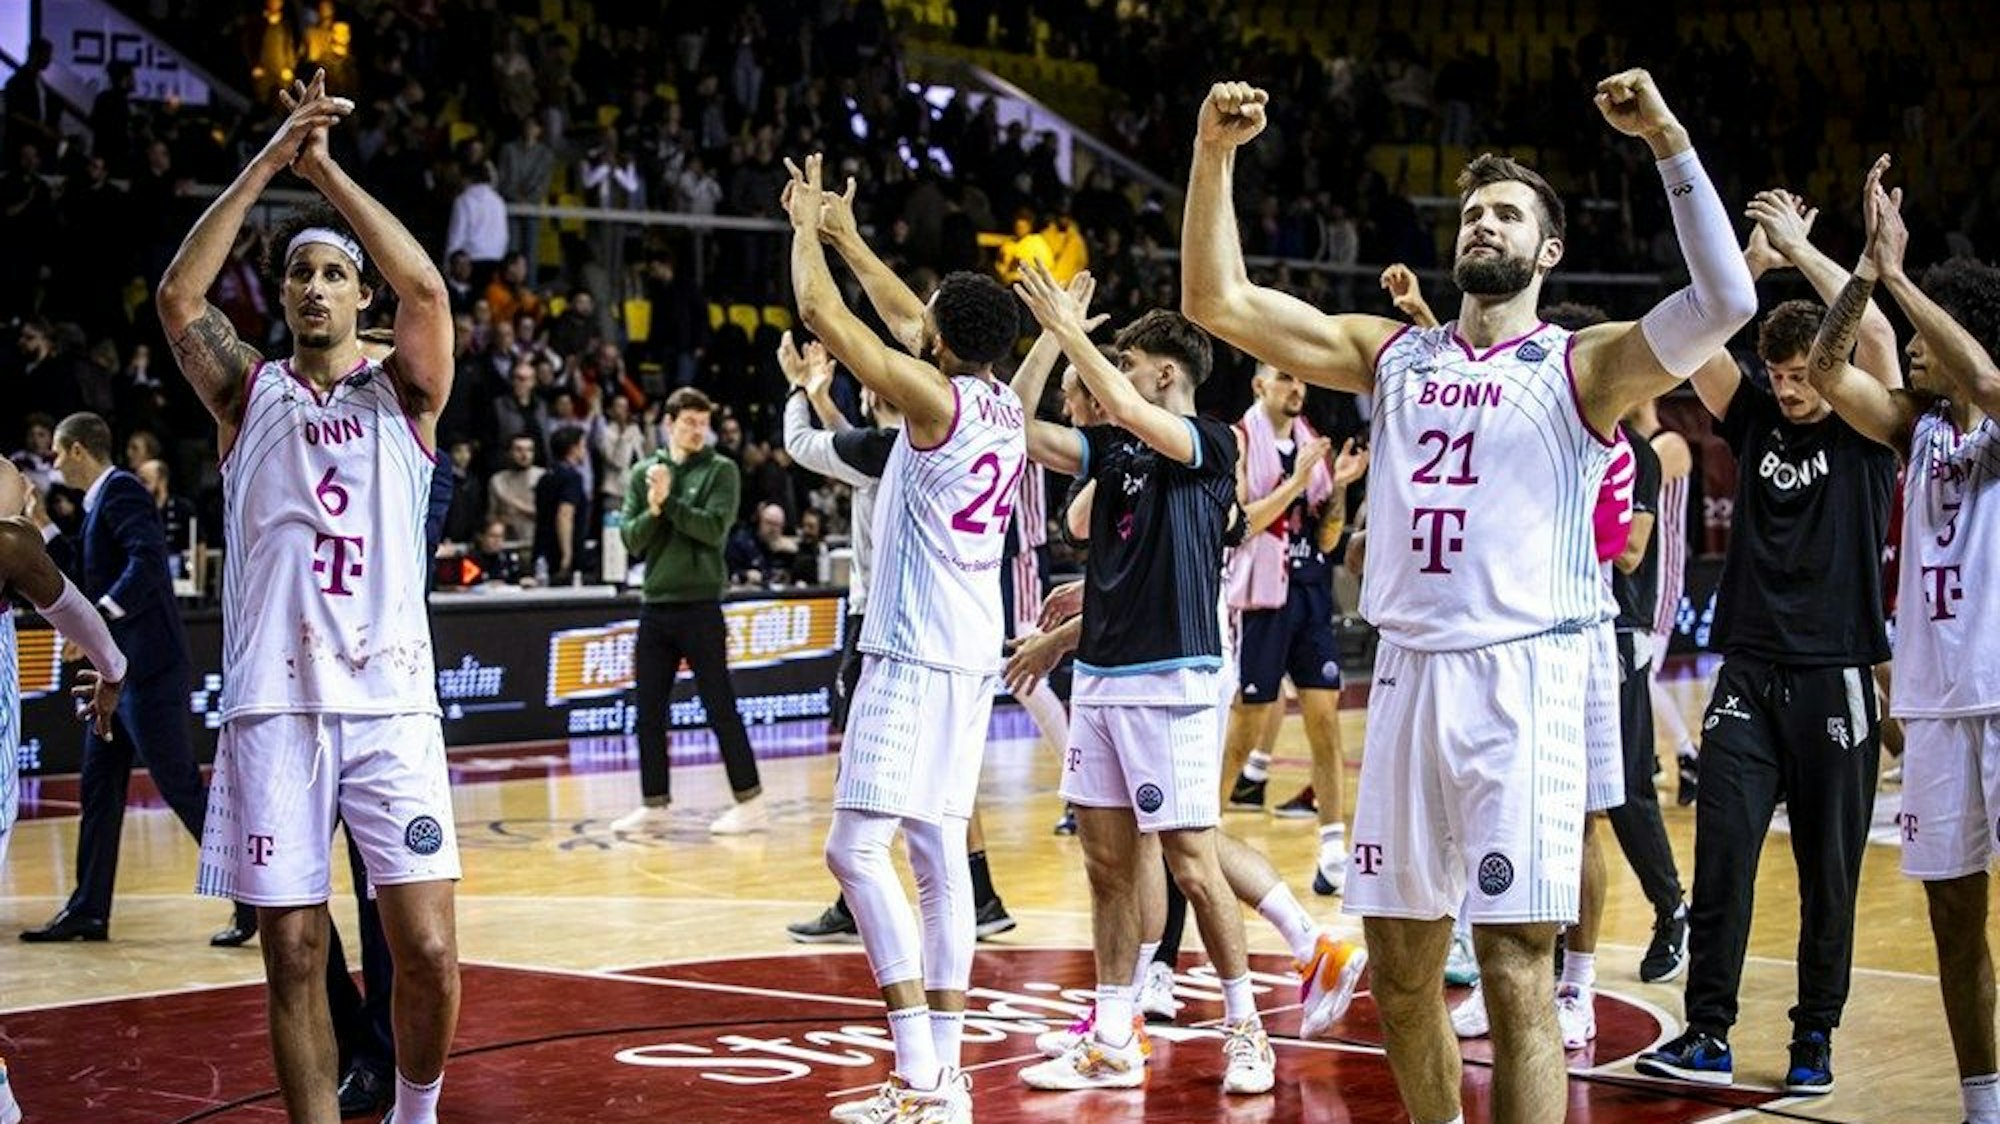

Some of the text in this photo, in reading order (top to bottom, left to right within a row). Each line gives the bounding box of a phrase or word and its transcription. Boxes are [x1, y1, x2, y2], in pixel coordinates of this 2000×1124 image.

[1418, 381, 1502, 408] BONN
[305, 414, 364, 447] ONN
[1411, 429, 1478, 485] 21
[1759, 450, 1829, 490] BONN
[316, 466, 348, 516] 6
[952, 452, 1025, 534] 24
[1936, 503, 1962, 548] 3
[736, 687, 831, 725] ngagement
